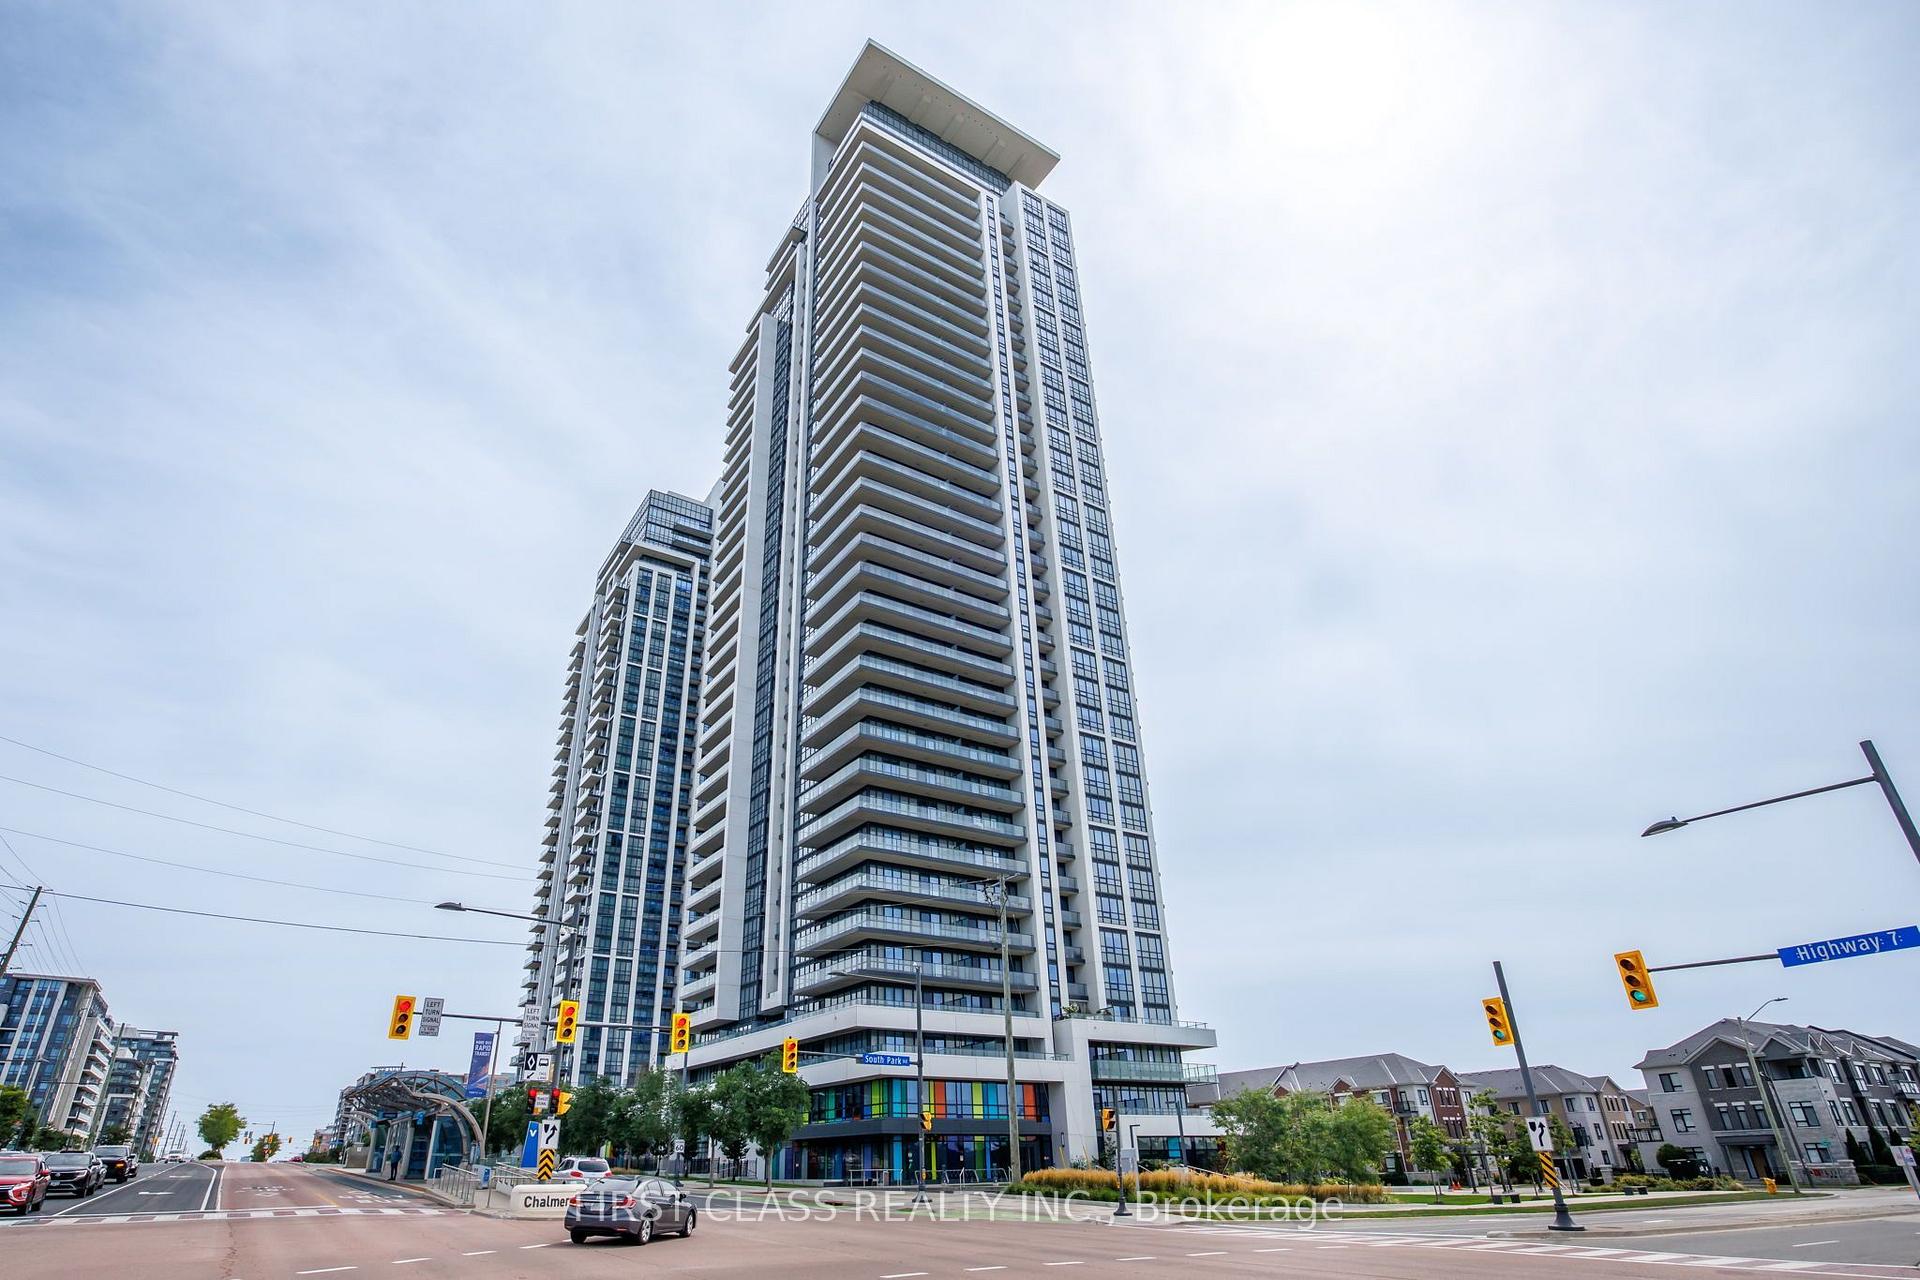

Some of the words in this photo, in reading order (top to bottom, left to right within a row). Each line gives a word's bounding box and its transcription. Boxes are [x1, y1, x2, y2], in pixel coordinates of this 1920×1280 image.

[1797, 935, 1880, 961] Highway
[1886, 931, 1898, 946] 7
[865, 1055, 885, 1064] South
[887, 1056, 902, 1065] Park
[675, 1144, 684, 1152] 60
